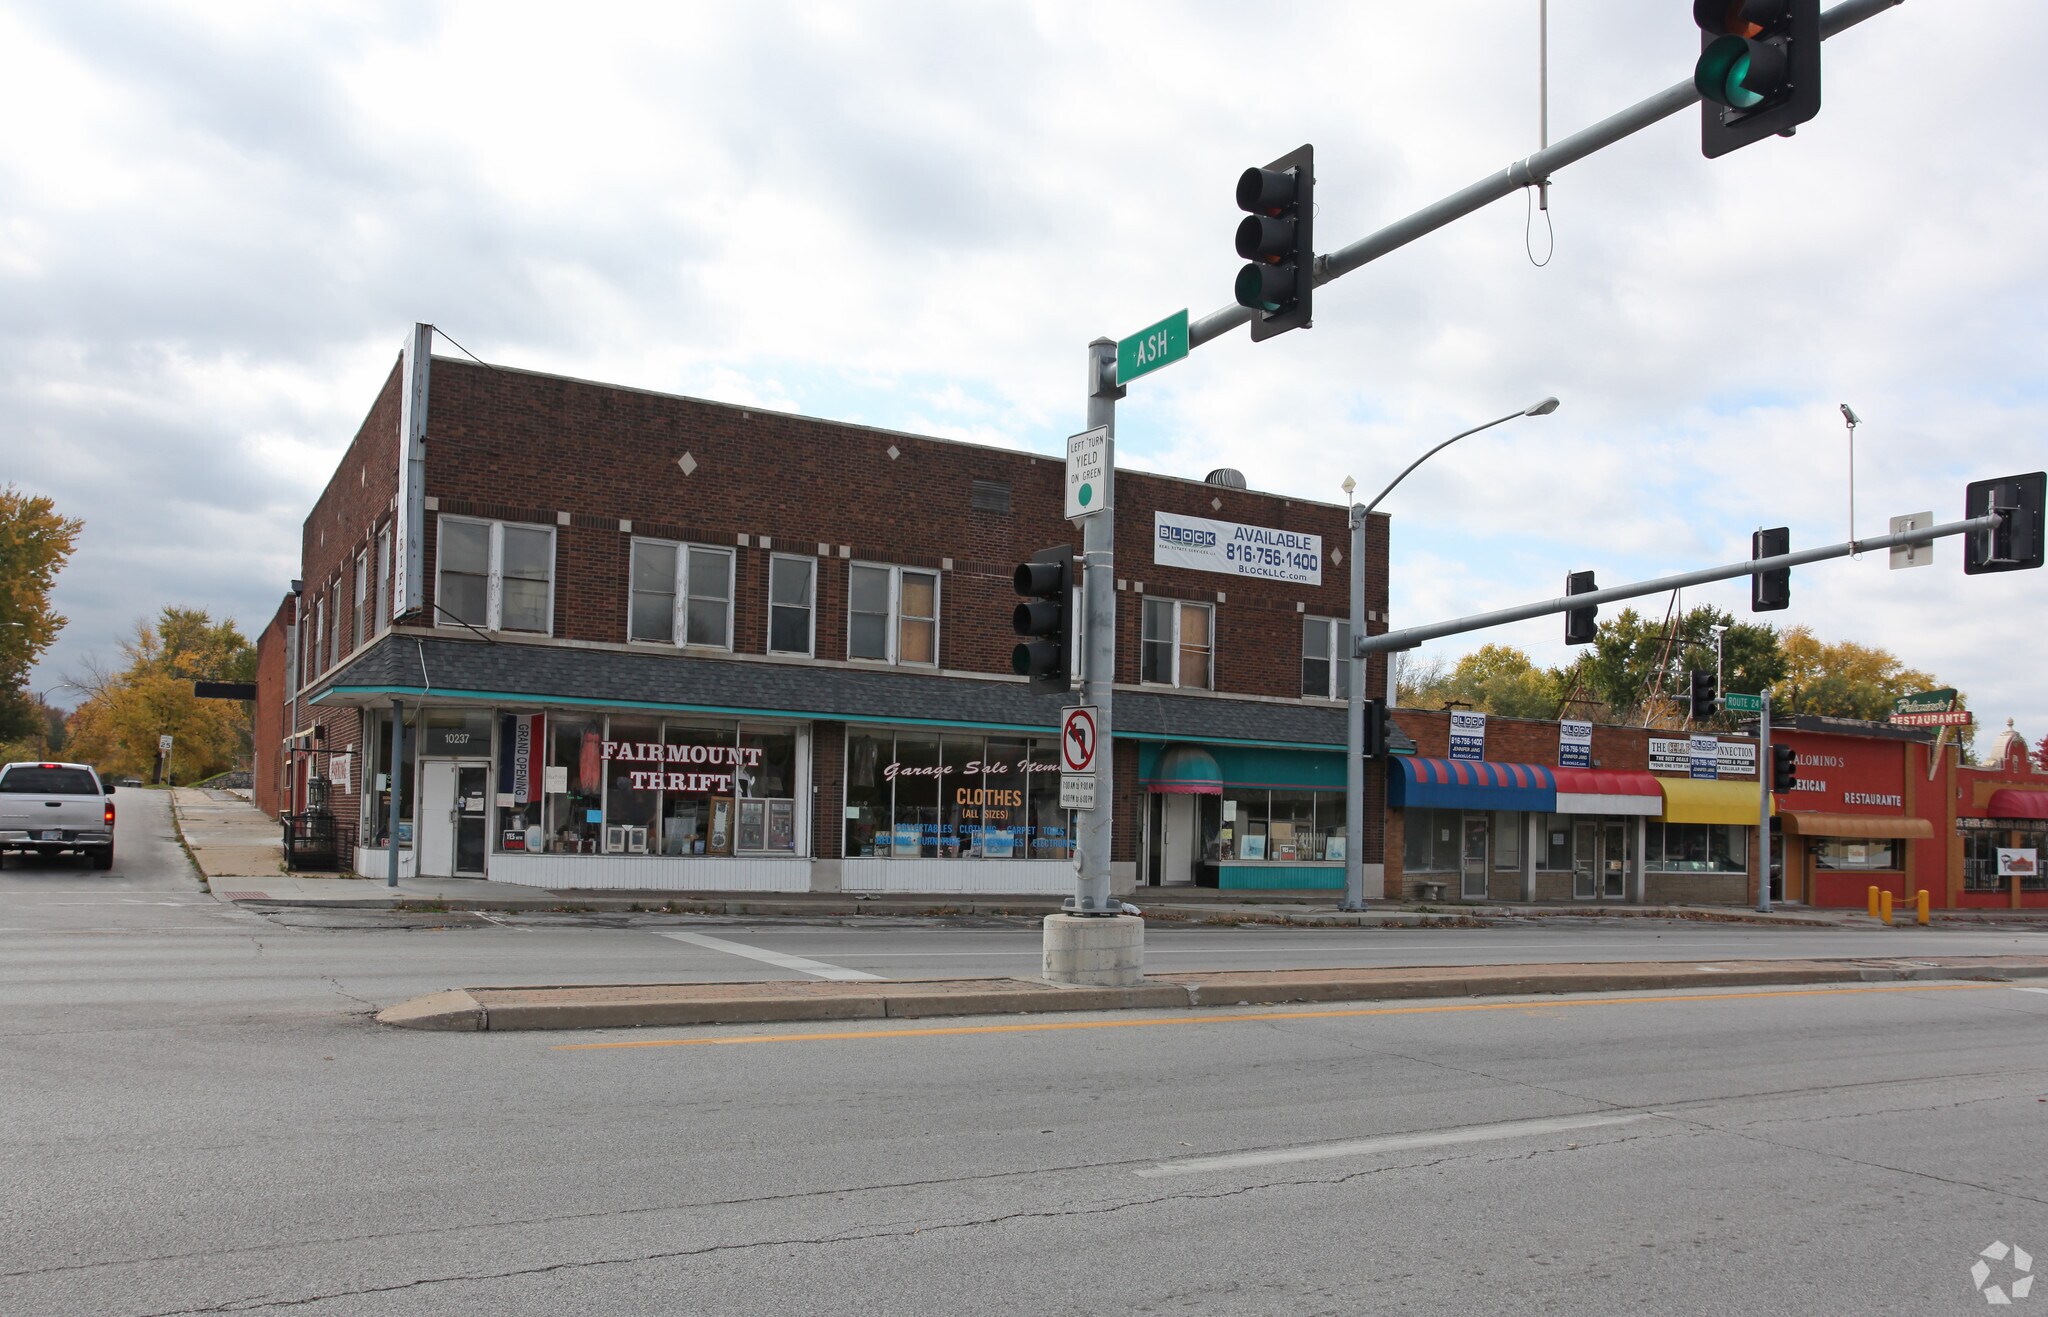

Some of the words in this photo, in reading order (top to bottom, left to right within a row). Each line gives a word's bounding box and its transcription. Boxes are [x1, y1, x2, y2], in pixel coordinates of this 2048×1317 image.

[1137, 329, 1167, 367] ASH
[1071, 440, 1084, 453] LEFT
[1088, 435, 1103, 447] TURN
[1076, 451, 1098, 468] YIELD
[1071, 474, 1079, 484] ON
[1082, 467, 1101, 480] GREEN
[1159, 525, 1216, 546] BLOCK
[1234, 526, 1312, 551] AVAILABLE
[1226, 542, 1318, 571] 816-756-1400
[1728, 697, 1748, 708] ROUTE
[1751, 699, 1759, 708] 24
[1452, 715, 1484, 726] BLOCK
[1890, 713, 1967, 726] RESTAURANTE
[1562, 724, 1591, 734] BLOCK
[445, 733, 470, 744] 10237
[517, 724, 529, 754] GRAND
[1691, 740, 1717, 749] BLOCK
[601, 741, 762, 766] FAIRMOUNT
[1652, 742, 1666, 752] THE
[1717, 746, 1753, 757] NNECTION
[515, 758, 528, 796] OPENING
[883, 762, 953, 782] Garage
[963, 760, 1008, 776] Sale
[630, 771, 731, 792] THRIFT
[956, 788, 1022, 807] CLOTHES
[1844, 792, 1901, 807] RESTAURANTE
[962, 808, 979, 819] (ALL
[984, 809, 1009, 820] SIZES)
[506, 832, 515, 840] YES
[959, 825, 997, 834] CLOTHNG
[1006, 826, 1036, 835] CARPET
[919, 837, 960, 847] URNTURE
[1032, 839, 1076, 848] ELECTRONCS
